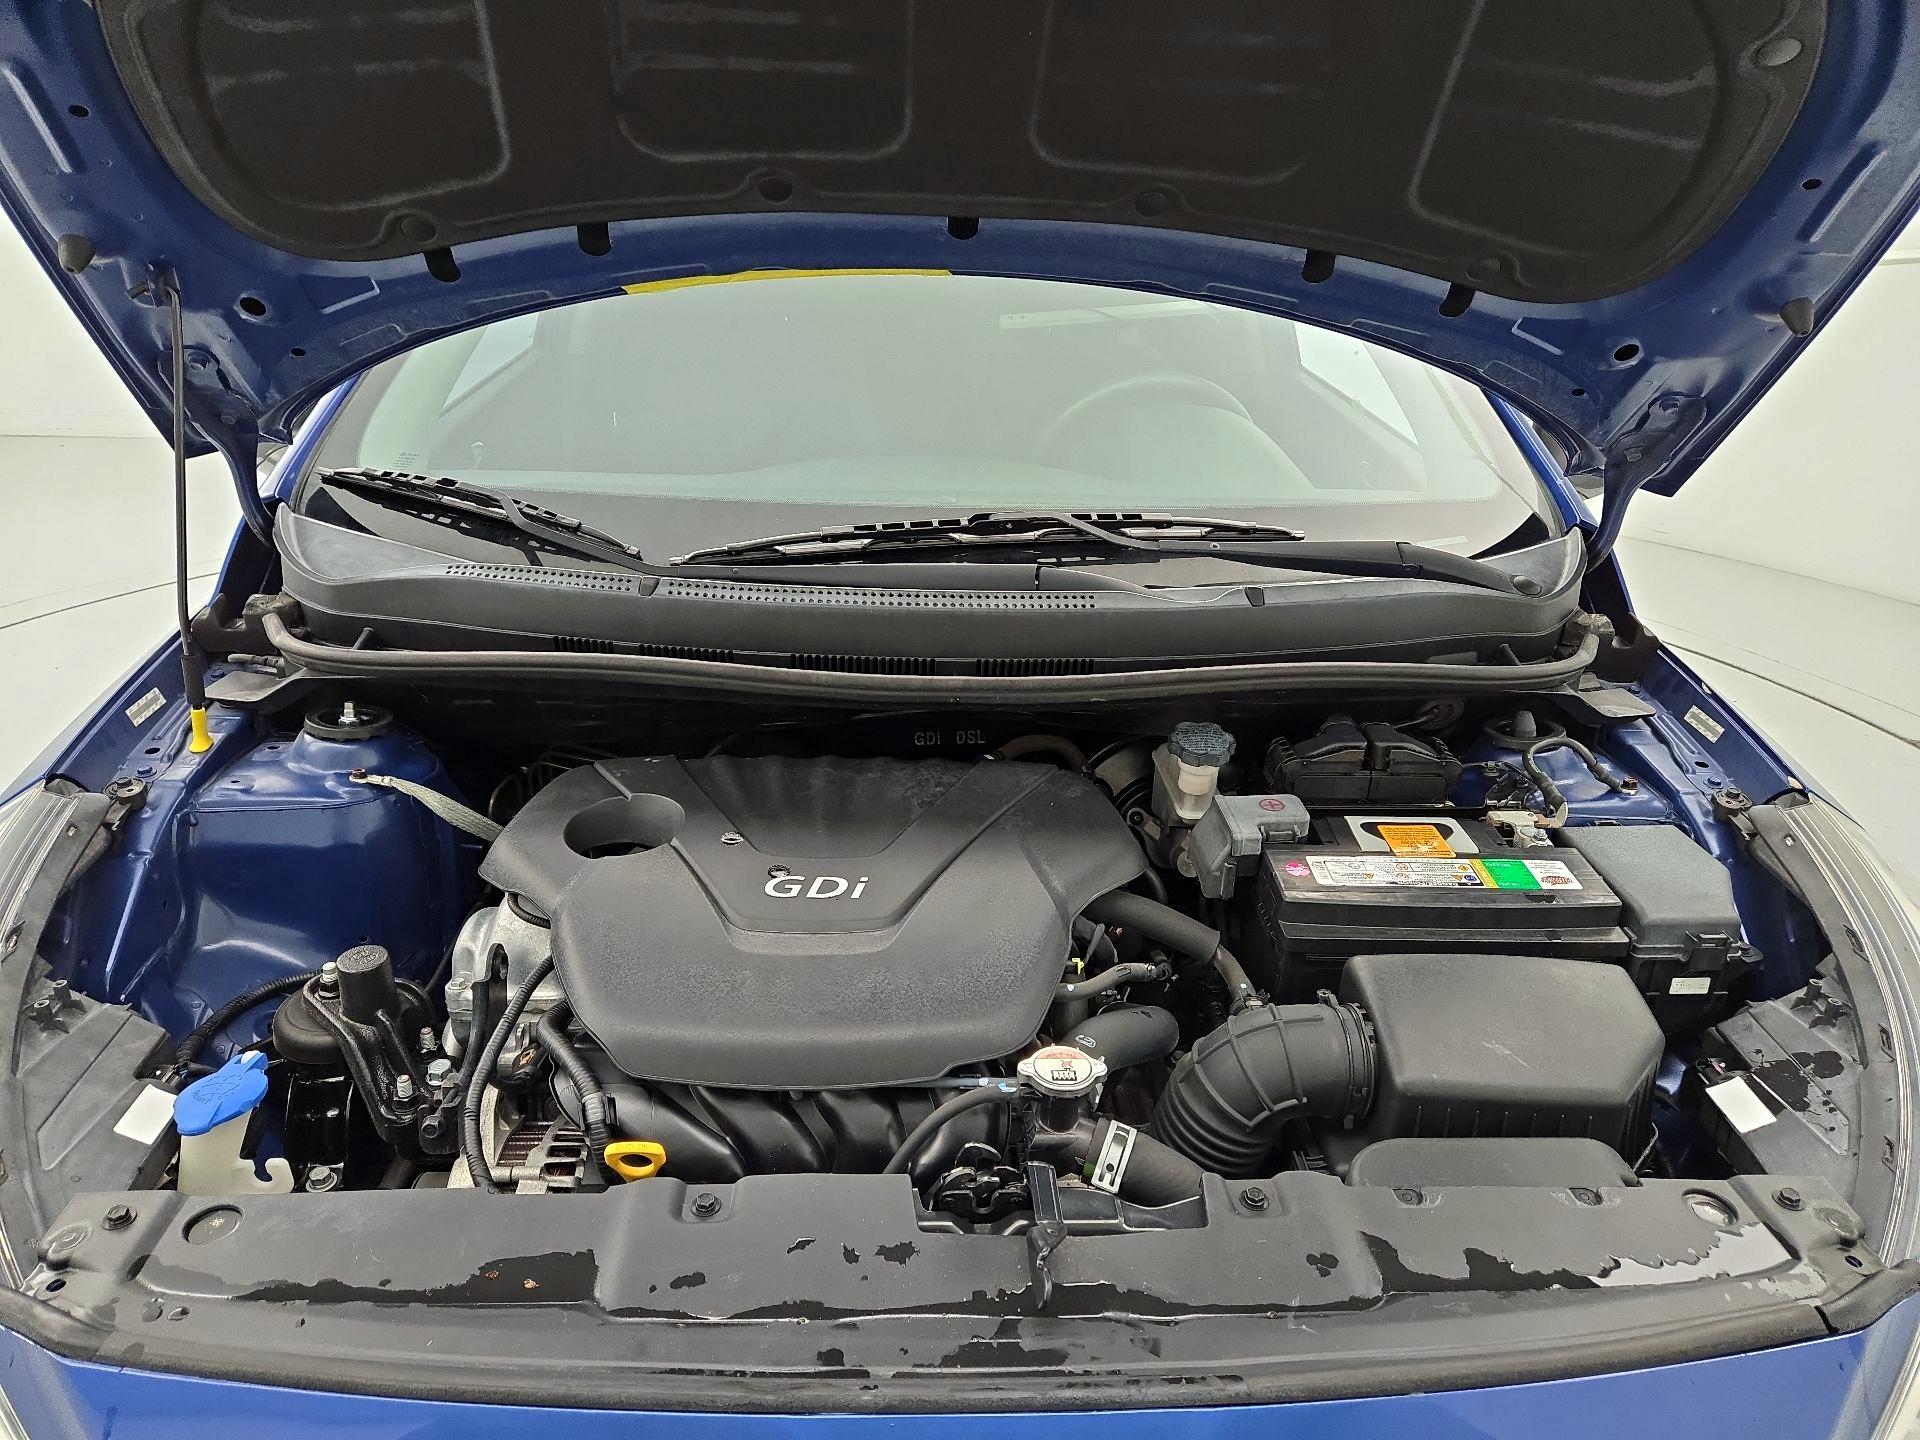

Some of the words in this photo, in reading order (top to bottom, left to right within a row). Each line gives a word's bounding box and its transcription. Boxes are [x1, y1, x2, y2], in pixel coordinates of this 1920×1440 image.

[914, 731, 941, 746] GDI
[956, 730, 986, 744] DSL
[764, 875, 869, 899] GDi
